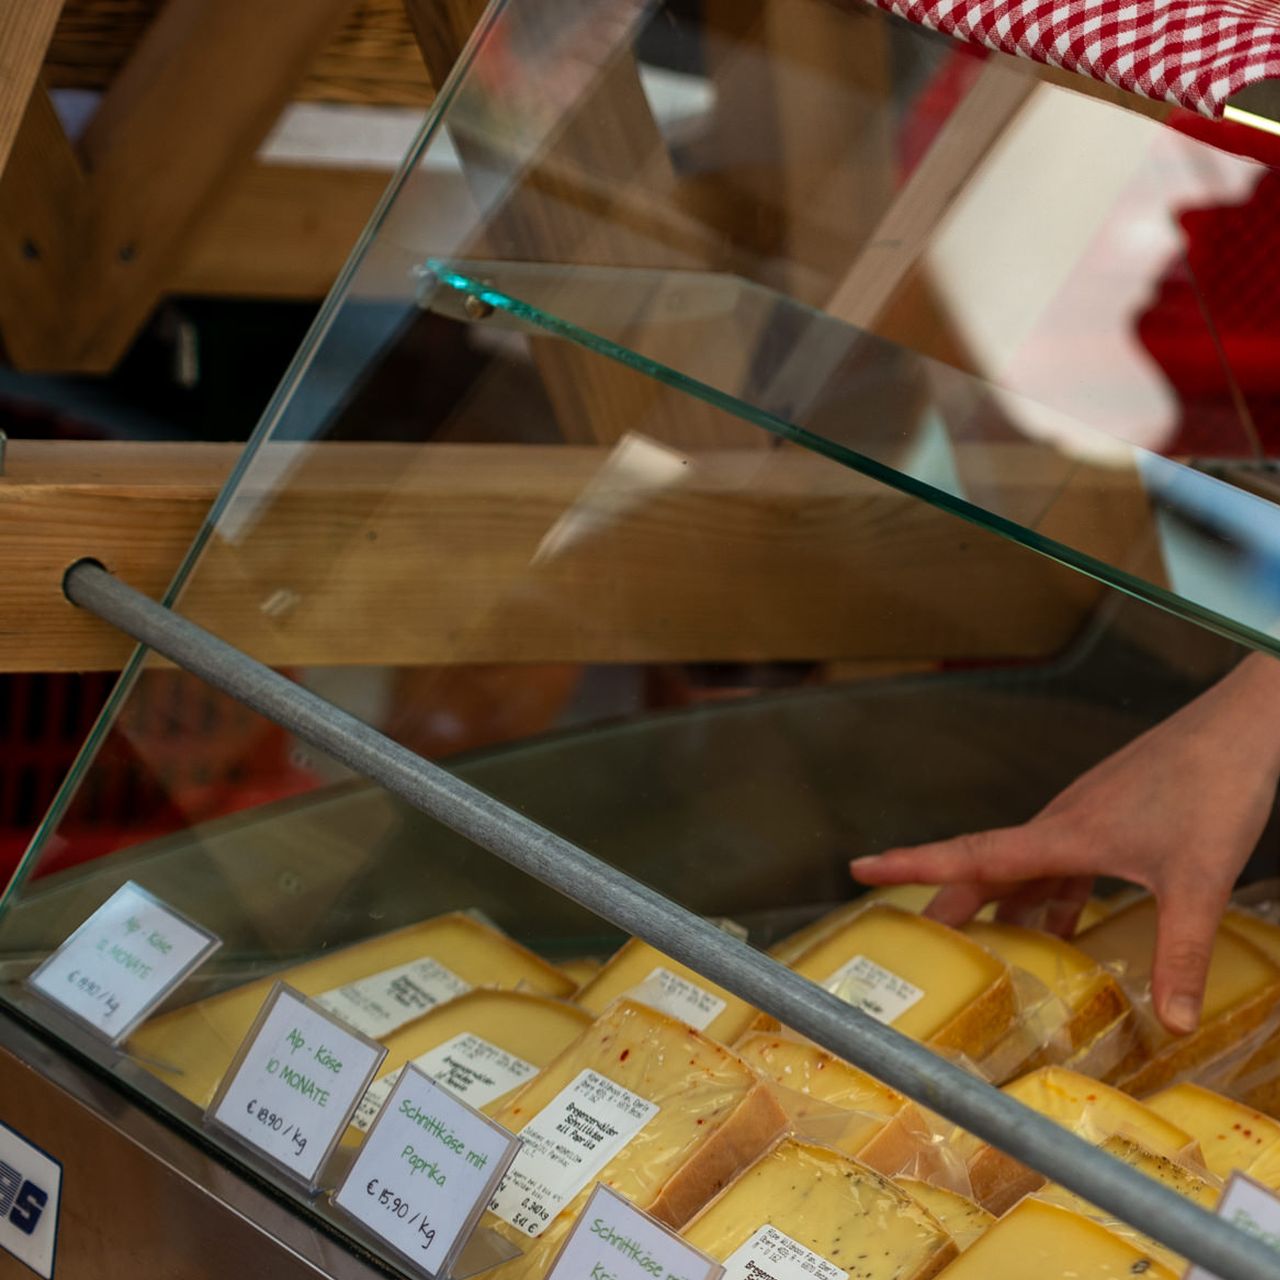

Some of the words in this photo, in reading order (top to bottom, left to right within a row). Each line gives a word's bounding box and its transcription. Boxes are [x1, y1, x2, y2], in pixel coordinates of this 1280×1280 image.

[286, 1027, 305, 1056] Alp
[313, 1044, 344, 1075] Käse
[279, 1064, 331, 1108] MONATE
[246, 1098, 258, 1115] €
[291, 1126, 308, 1156] kg
[398, 1098, 466, 1155] Schnittkäse
[465, 1148, 488, 1172] mit
[564, 1114, 603, 1142] Schnittkäse
[565, 1101, 618, 1136] Bregenzerwälder
[568, 1129, 595, 1150] Paprika
[400, 1144, 448, 1189] Paprika
[366, 1178, 379, 1197] €
[378, 1188, 410, 1220] 15,90
[417, 1214, 437, 1250] kg
[527, 1222, 538, 1233] €
[590, 1218, 664, 1279] Schnittkäse
